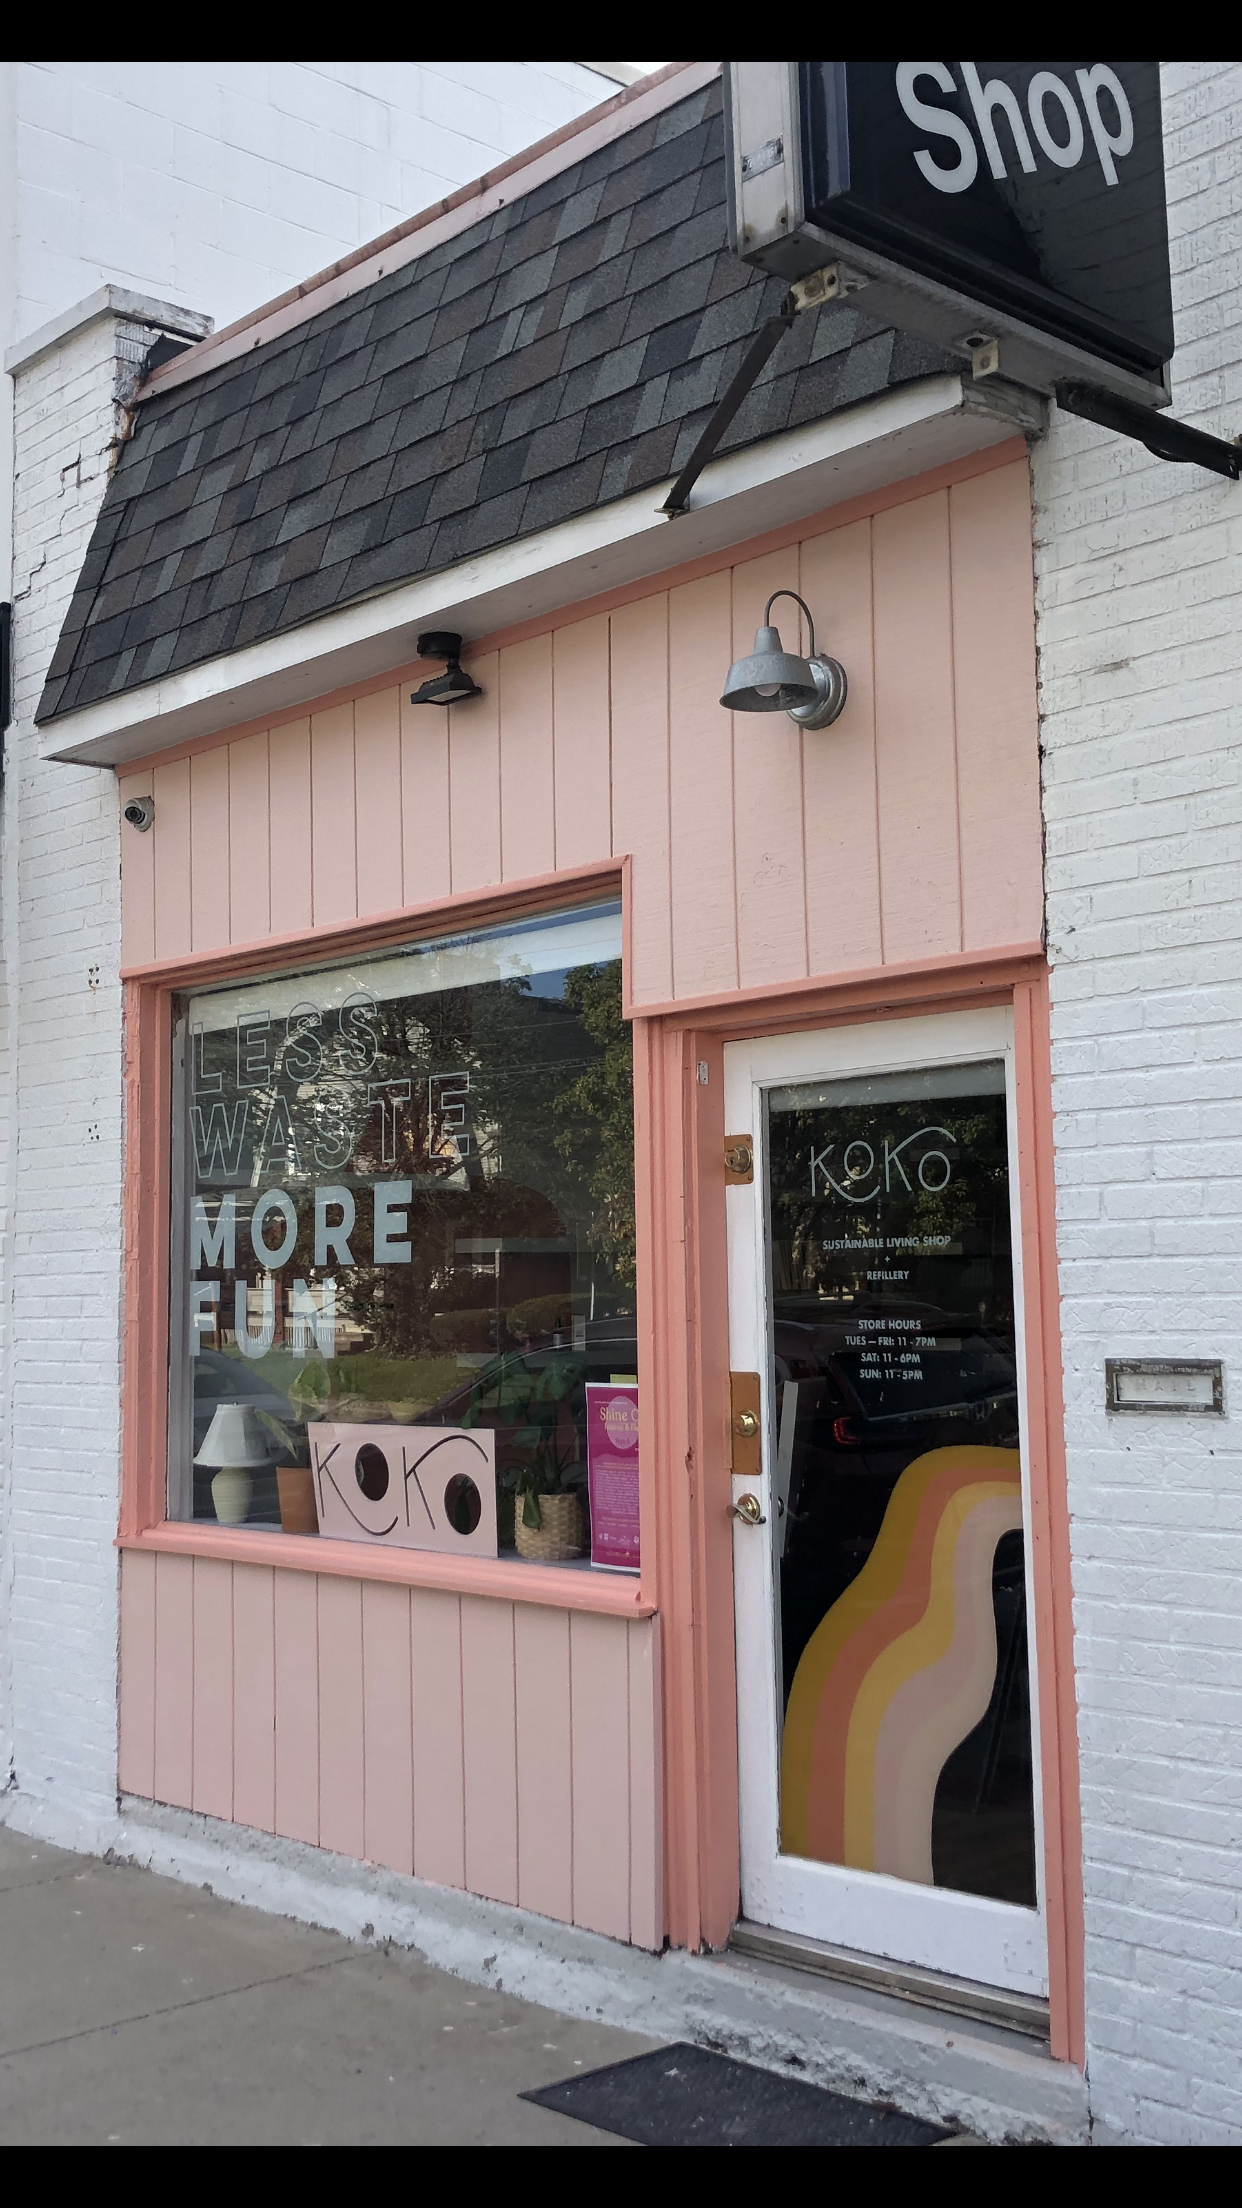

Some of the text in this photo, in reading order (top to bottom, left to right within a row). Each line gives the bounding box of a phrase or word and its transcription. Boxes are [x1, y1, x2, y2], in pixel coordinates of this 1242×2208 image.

[895, 62, 1134, 194] Shop
[191, 991, 380, 1096] LESS
[188, 1070, 472, 1178] WASTE
[808, 1126, 957, 1203] KOKO
[189, 1179, 413, 1270] MORE
[822, 1235, 952, 1250] SUSTAINABLE LIVING SHOP
[866, 1270, 910, 1280] REFILLERY
[189, 1277, 337, 1360] FUN
[845, 1335, 867, 1346] TUES
[878, 1336, 895, 1346] FRI:
[897, 1336, 907, 1346] 11
[915, 1337, 937, 1347] 7PM
[858, 1319, 922, 1330] STORE HOURS
[859, 1368, 882, 1379] SUN:
[884, 1369, 894, 1379] 11
[902, 1370, 923, 1380] 5PM
[860, 1352, 880, 1362] SAT:
[882, 1352, 892, 1362] 11
[900, 1353, 921, 1363] 6PM
[599, 1406, 628, 1421] Shine
[313, 1434, 490, 1536] KOKO
